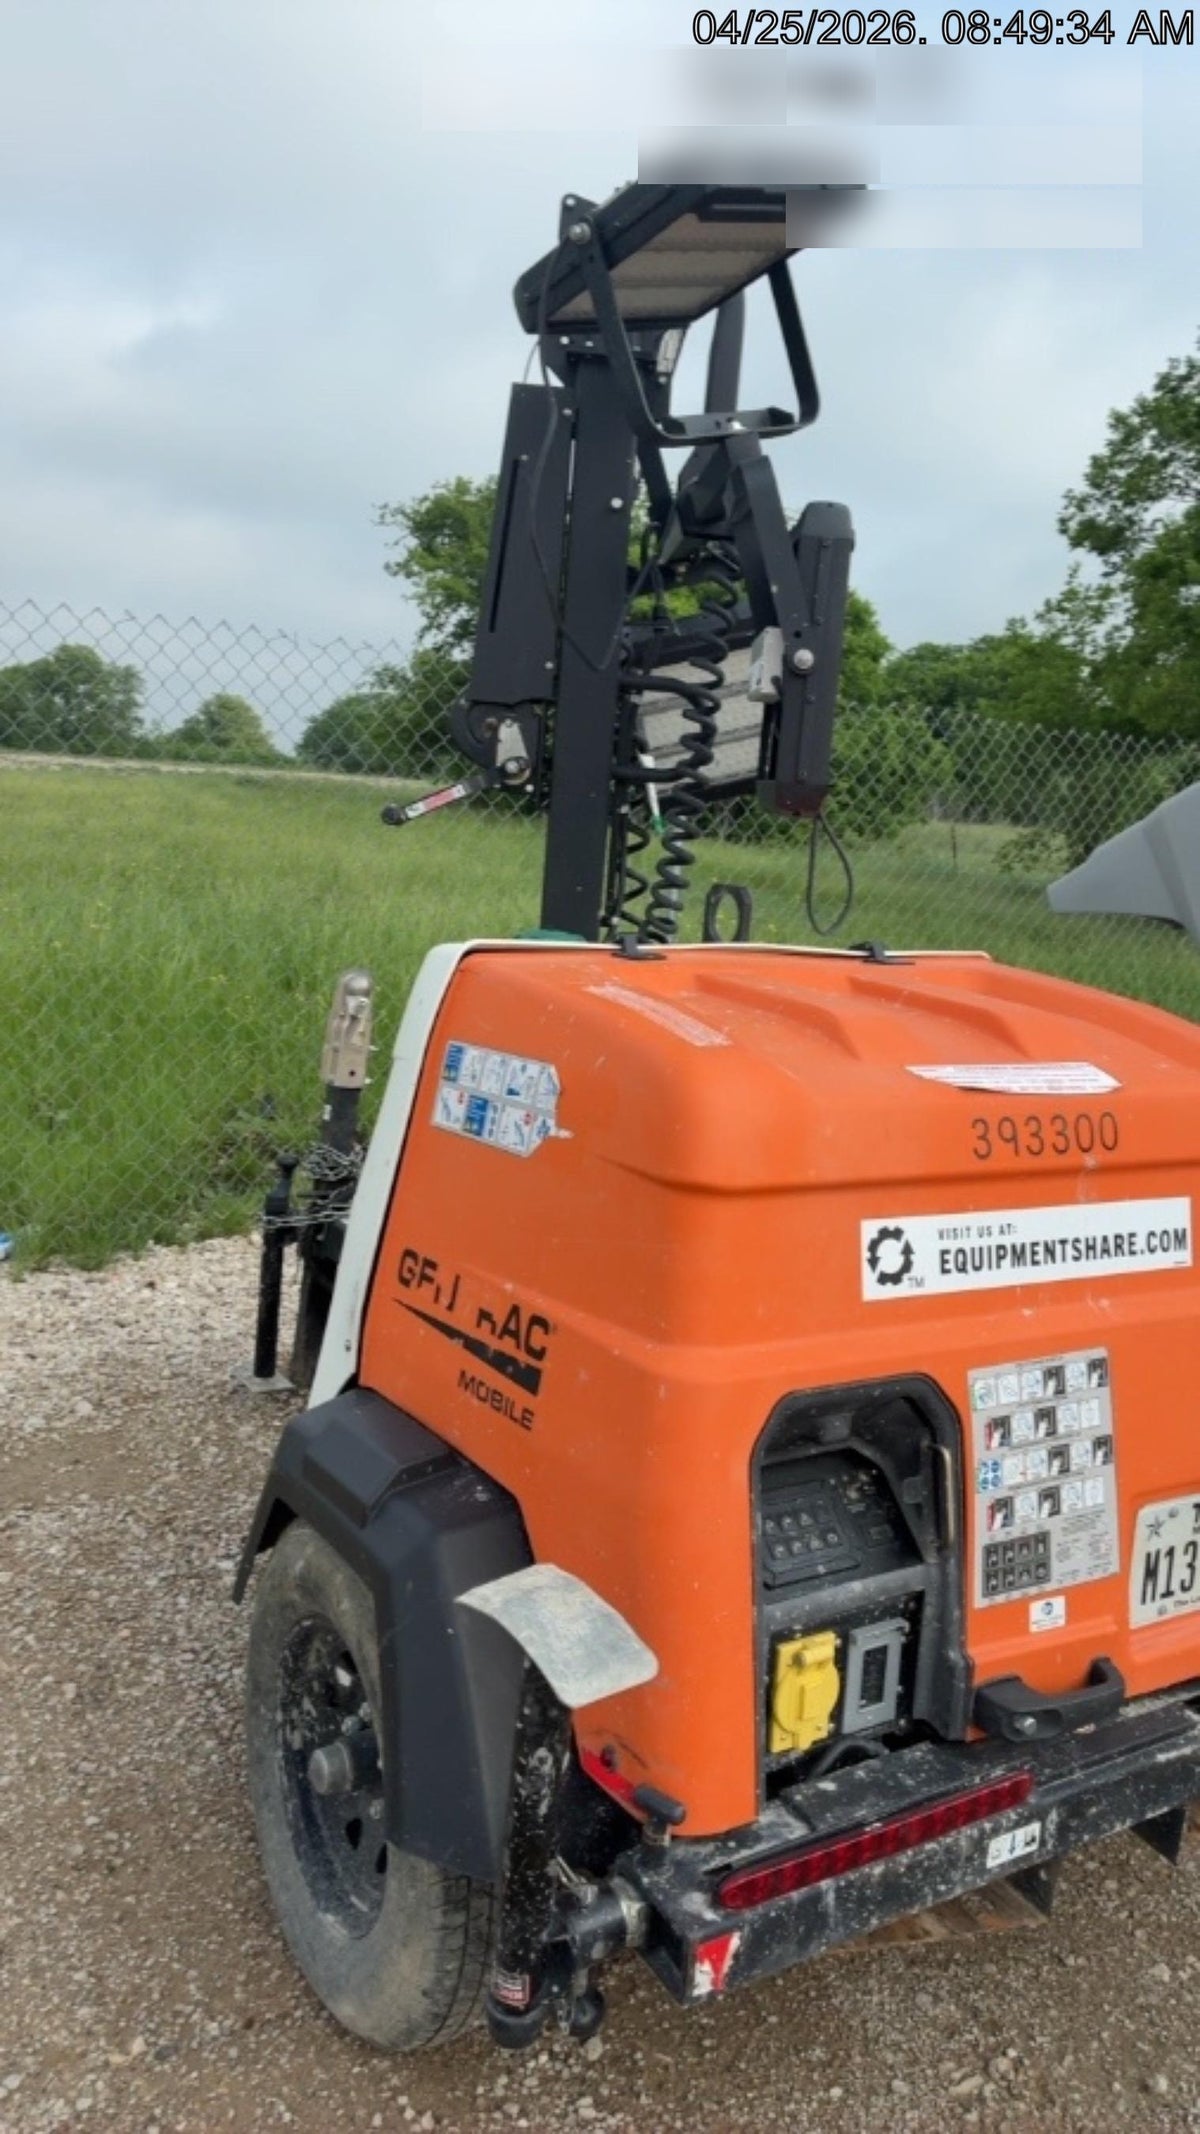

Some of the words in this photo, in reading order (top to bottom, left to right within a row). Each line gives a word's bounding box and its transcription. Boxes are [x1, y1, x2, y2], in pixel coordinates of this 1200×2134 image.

[971, 1112, 1119, 1160] 393300
[937, 1226, 972, 1241] VISIT
[976, 1225, 993, 1239] US
[998, 1223, 1018, 1236] AT:
[939, 1228, 1188, 1275] EQUIPMENTSHARE.COM
[457, 1369, 535, 1431] MOBILE
[1140, 1540, 1198, 1605] M13
